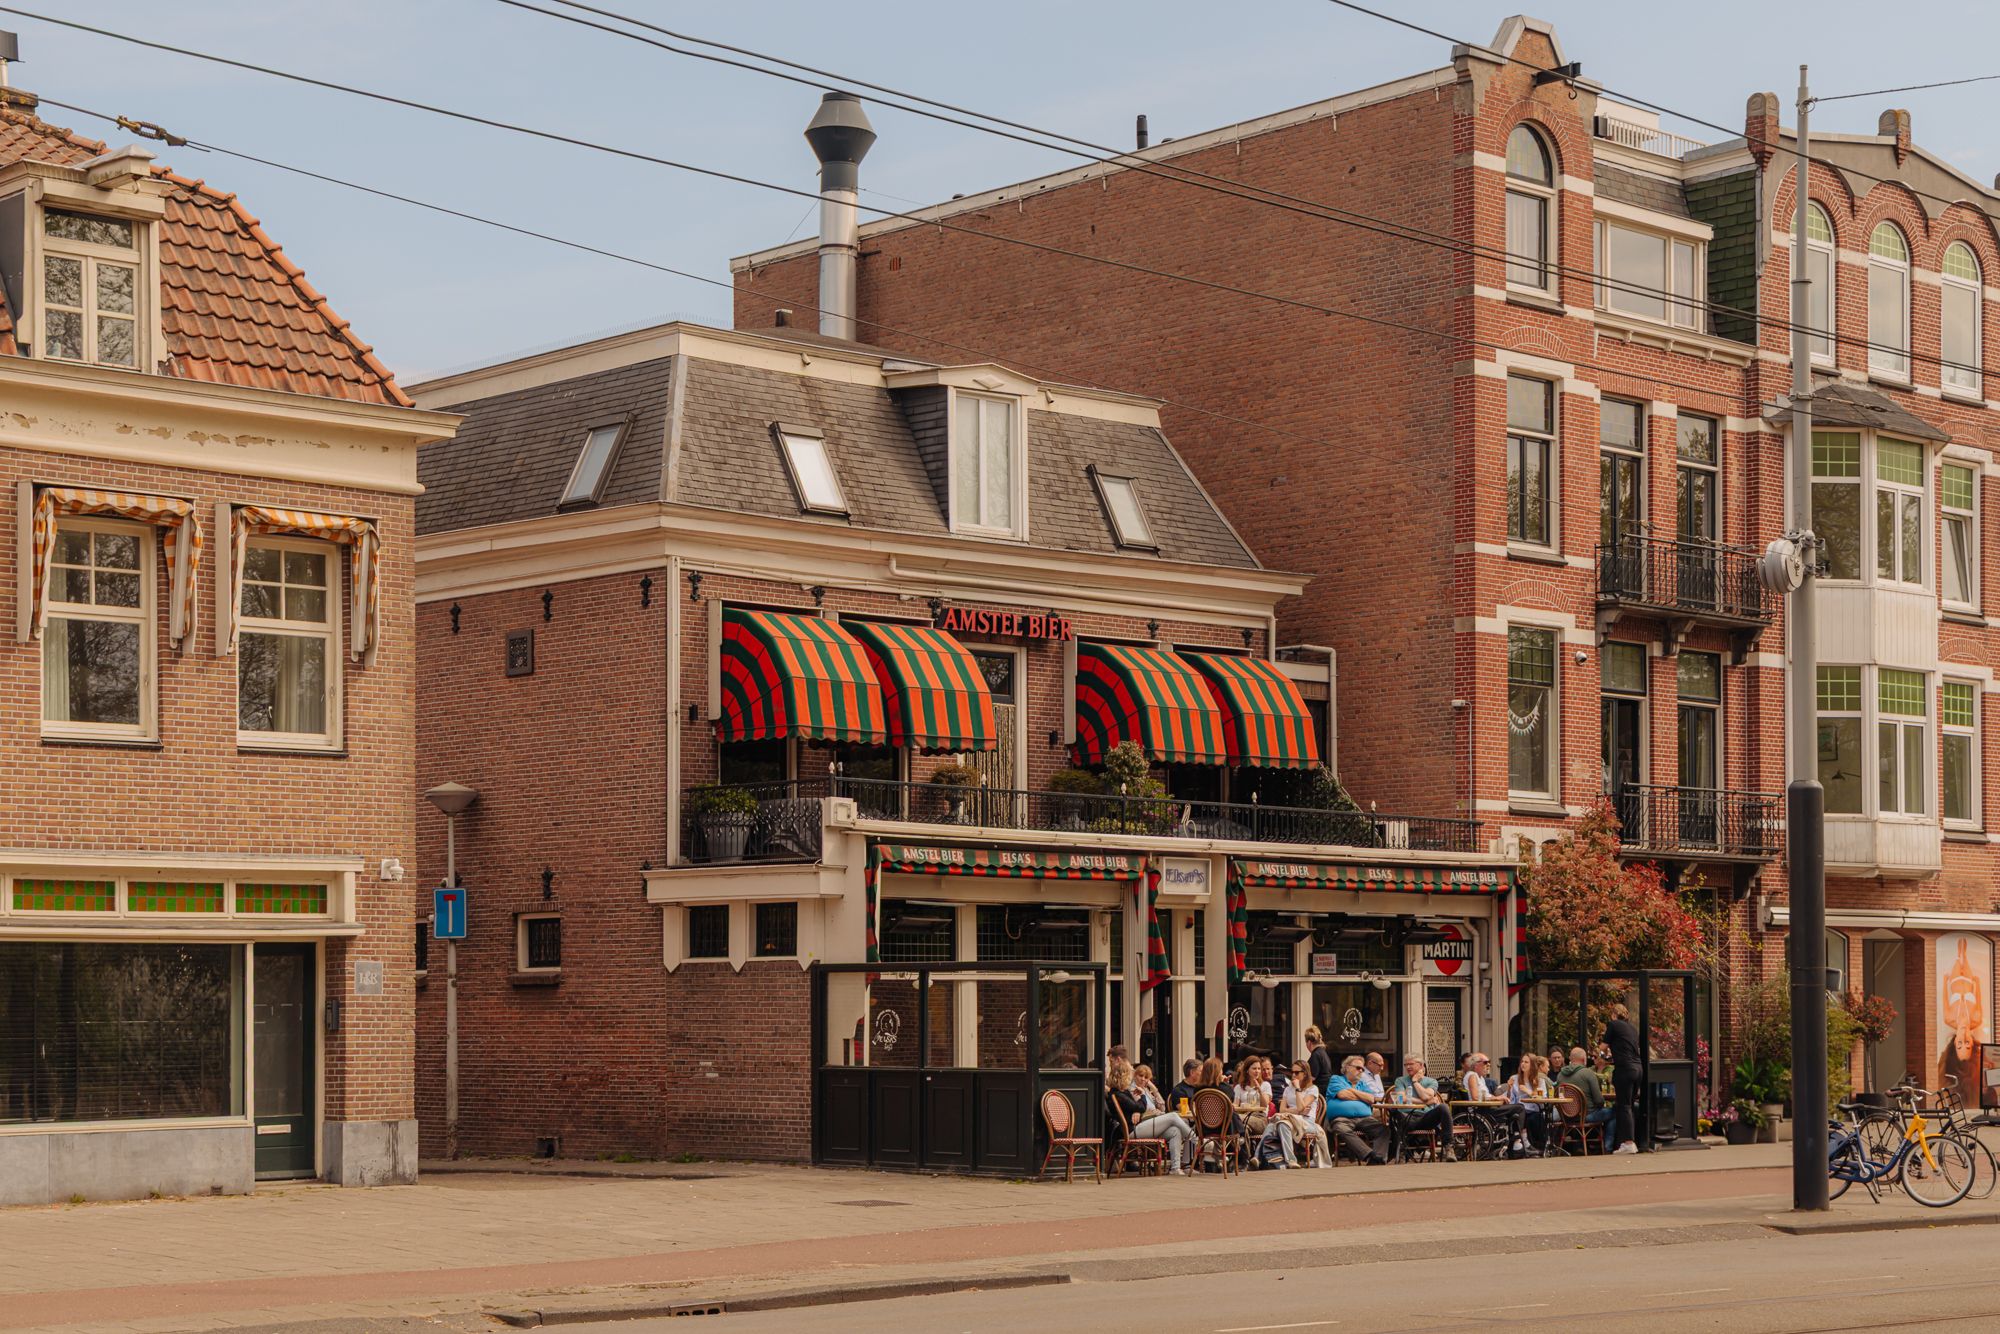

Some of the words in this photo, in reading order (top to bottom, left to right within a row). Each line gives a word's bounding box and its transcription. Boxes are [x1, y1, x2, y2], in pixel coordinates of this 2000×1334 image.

[943, 607, 1023, 637] AMSTEL
[1028, 615, 1073, 641] BIER
[903, 848, 940, 861] AMSTEL
[941, 849, 964, 862] BIER
[1002, 852, 1031, 864] ELSA'S
[1070, 855, 1105, 867] AMSTEL
[1106, 856, 1128, 868] BIER
[1259, 863, 1289, 875] AMSTEL
[1290, 865, 1309, 876] BIER
[1368, 869, 1392, 879] ELSA'S
[1450, 871, 1478, 882] AMSTEL
[1478, 872, 1497, 882] BIER
[1424, 941, 1472, 958] MARTINI
